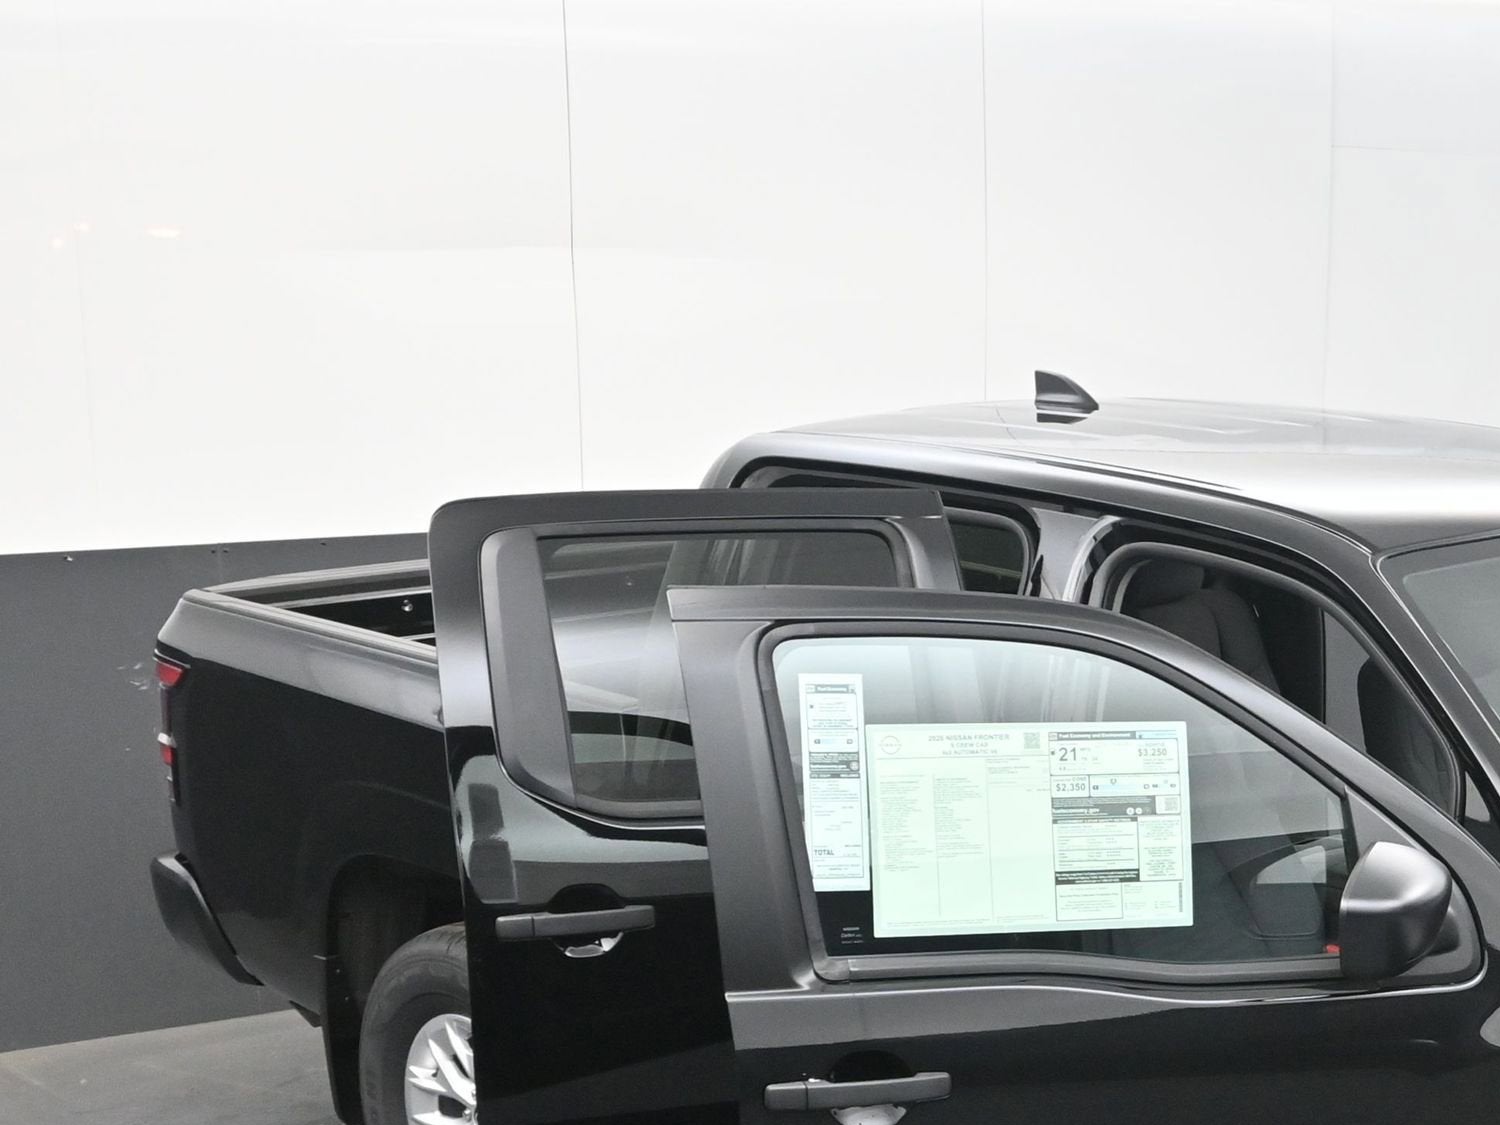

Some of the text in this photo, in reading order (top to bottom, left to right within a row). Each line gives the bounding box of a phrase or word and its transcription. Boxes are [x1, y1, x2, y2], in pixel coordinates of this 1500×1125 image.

[1058, 746, 1077, 761] 21
[1056, 783, 1086, 793] $2,350
[814, 848, 835, 856] TOTAL
